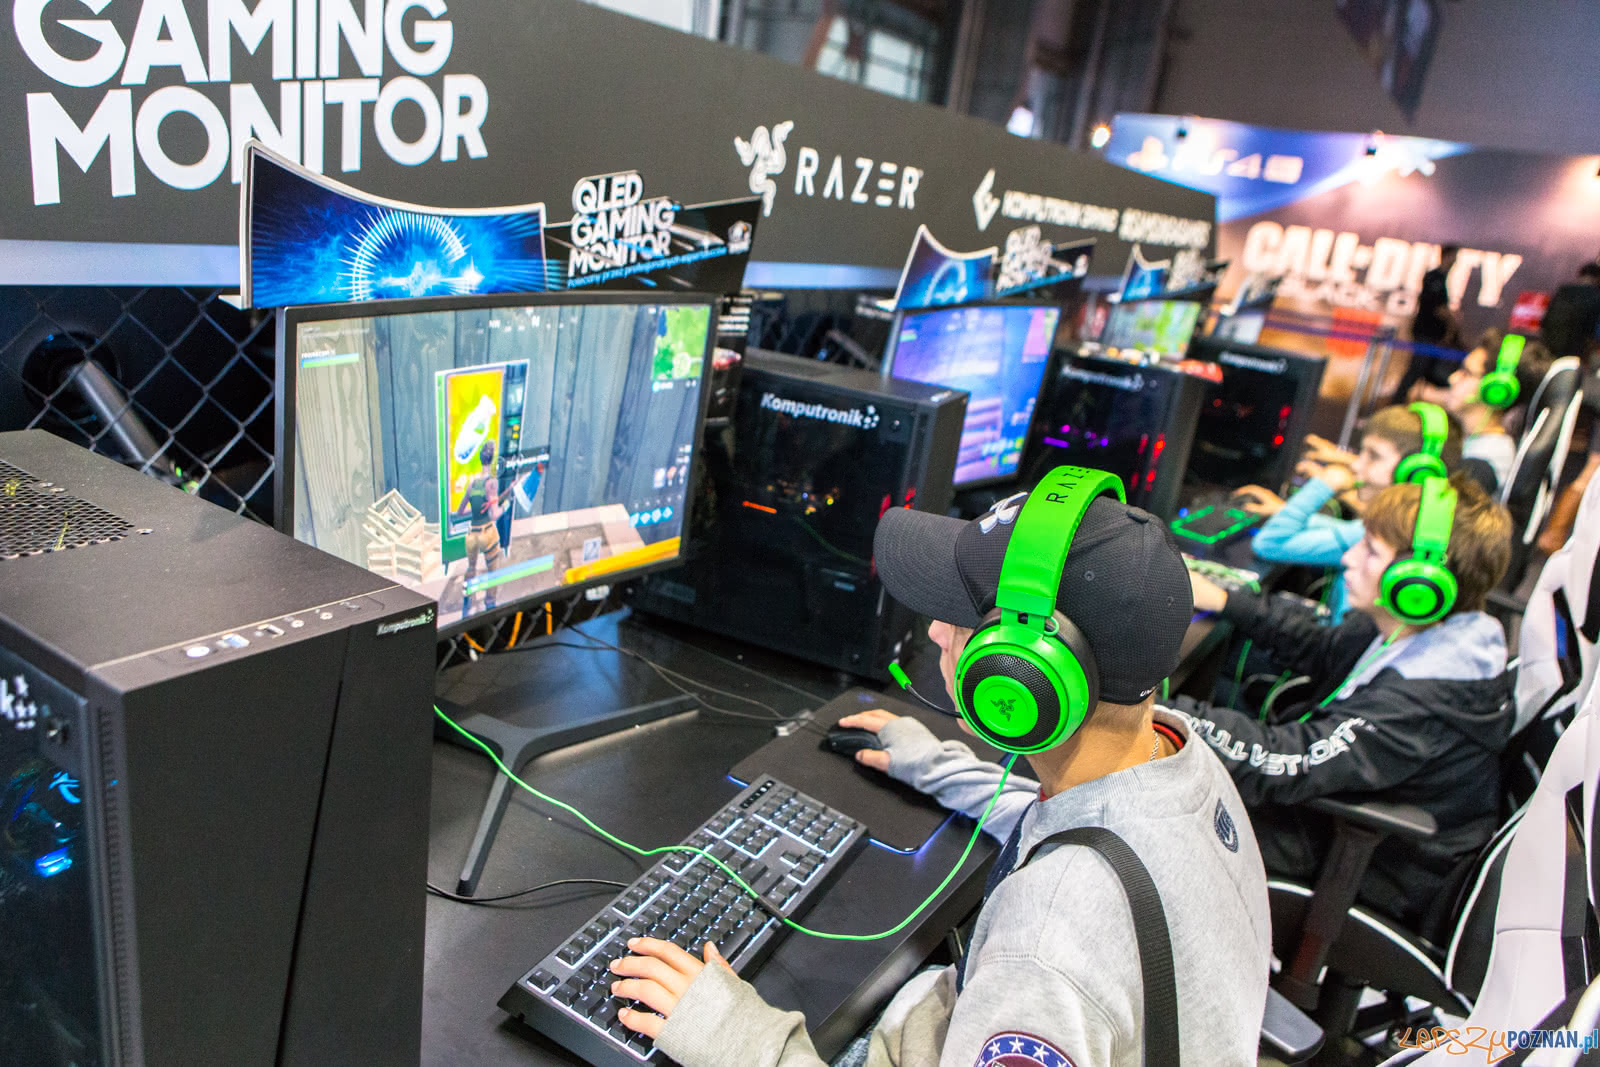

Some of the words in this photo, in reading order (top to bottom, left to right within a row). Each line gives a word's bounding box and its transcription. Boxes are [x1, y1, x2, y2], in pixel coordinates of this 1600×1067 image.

[13, 0, 453, 87] GAMING
[26, 74, 489, 205] MONITOR
[574, 173, 643, 214] QLED
[794, 146, 920, 210] RAZER
[571, 200, 675, 247] GAMING
[568, 231, 672, 277] MONITOR
[1243, 221, 1360, 284] CALL
[760, 392, 864, 428] Komputronik
